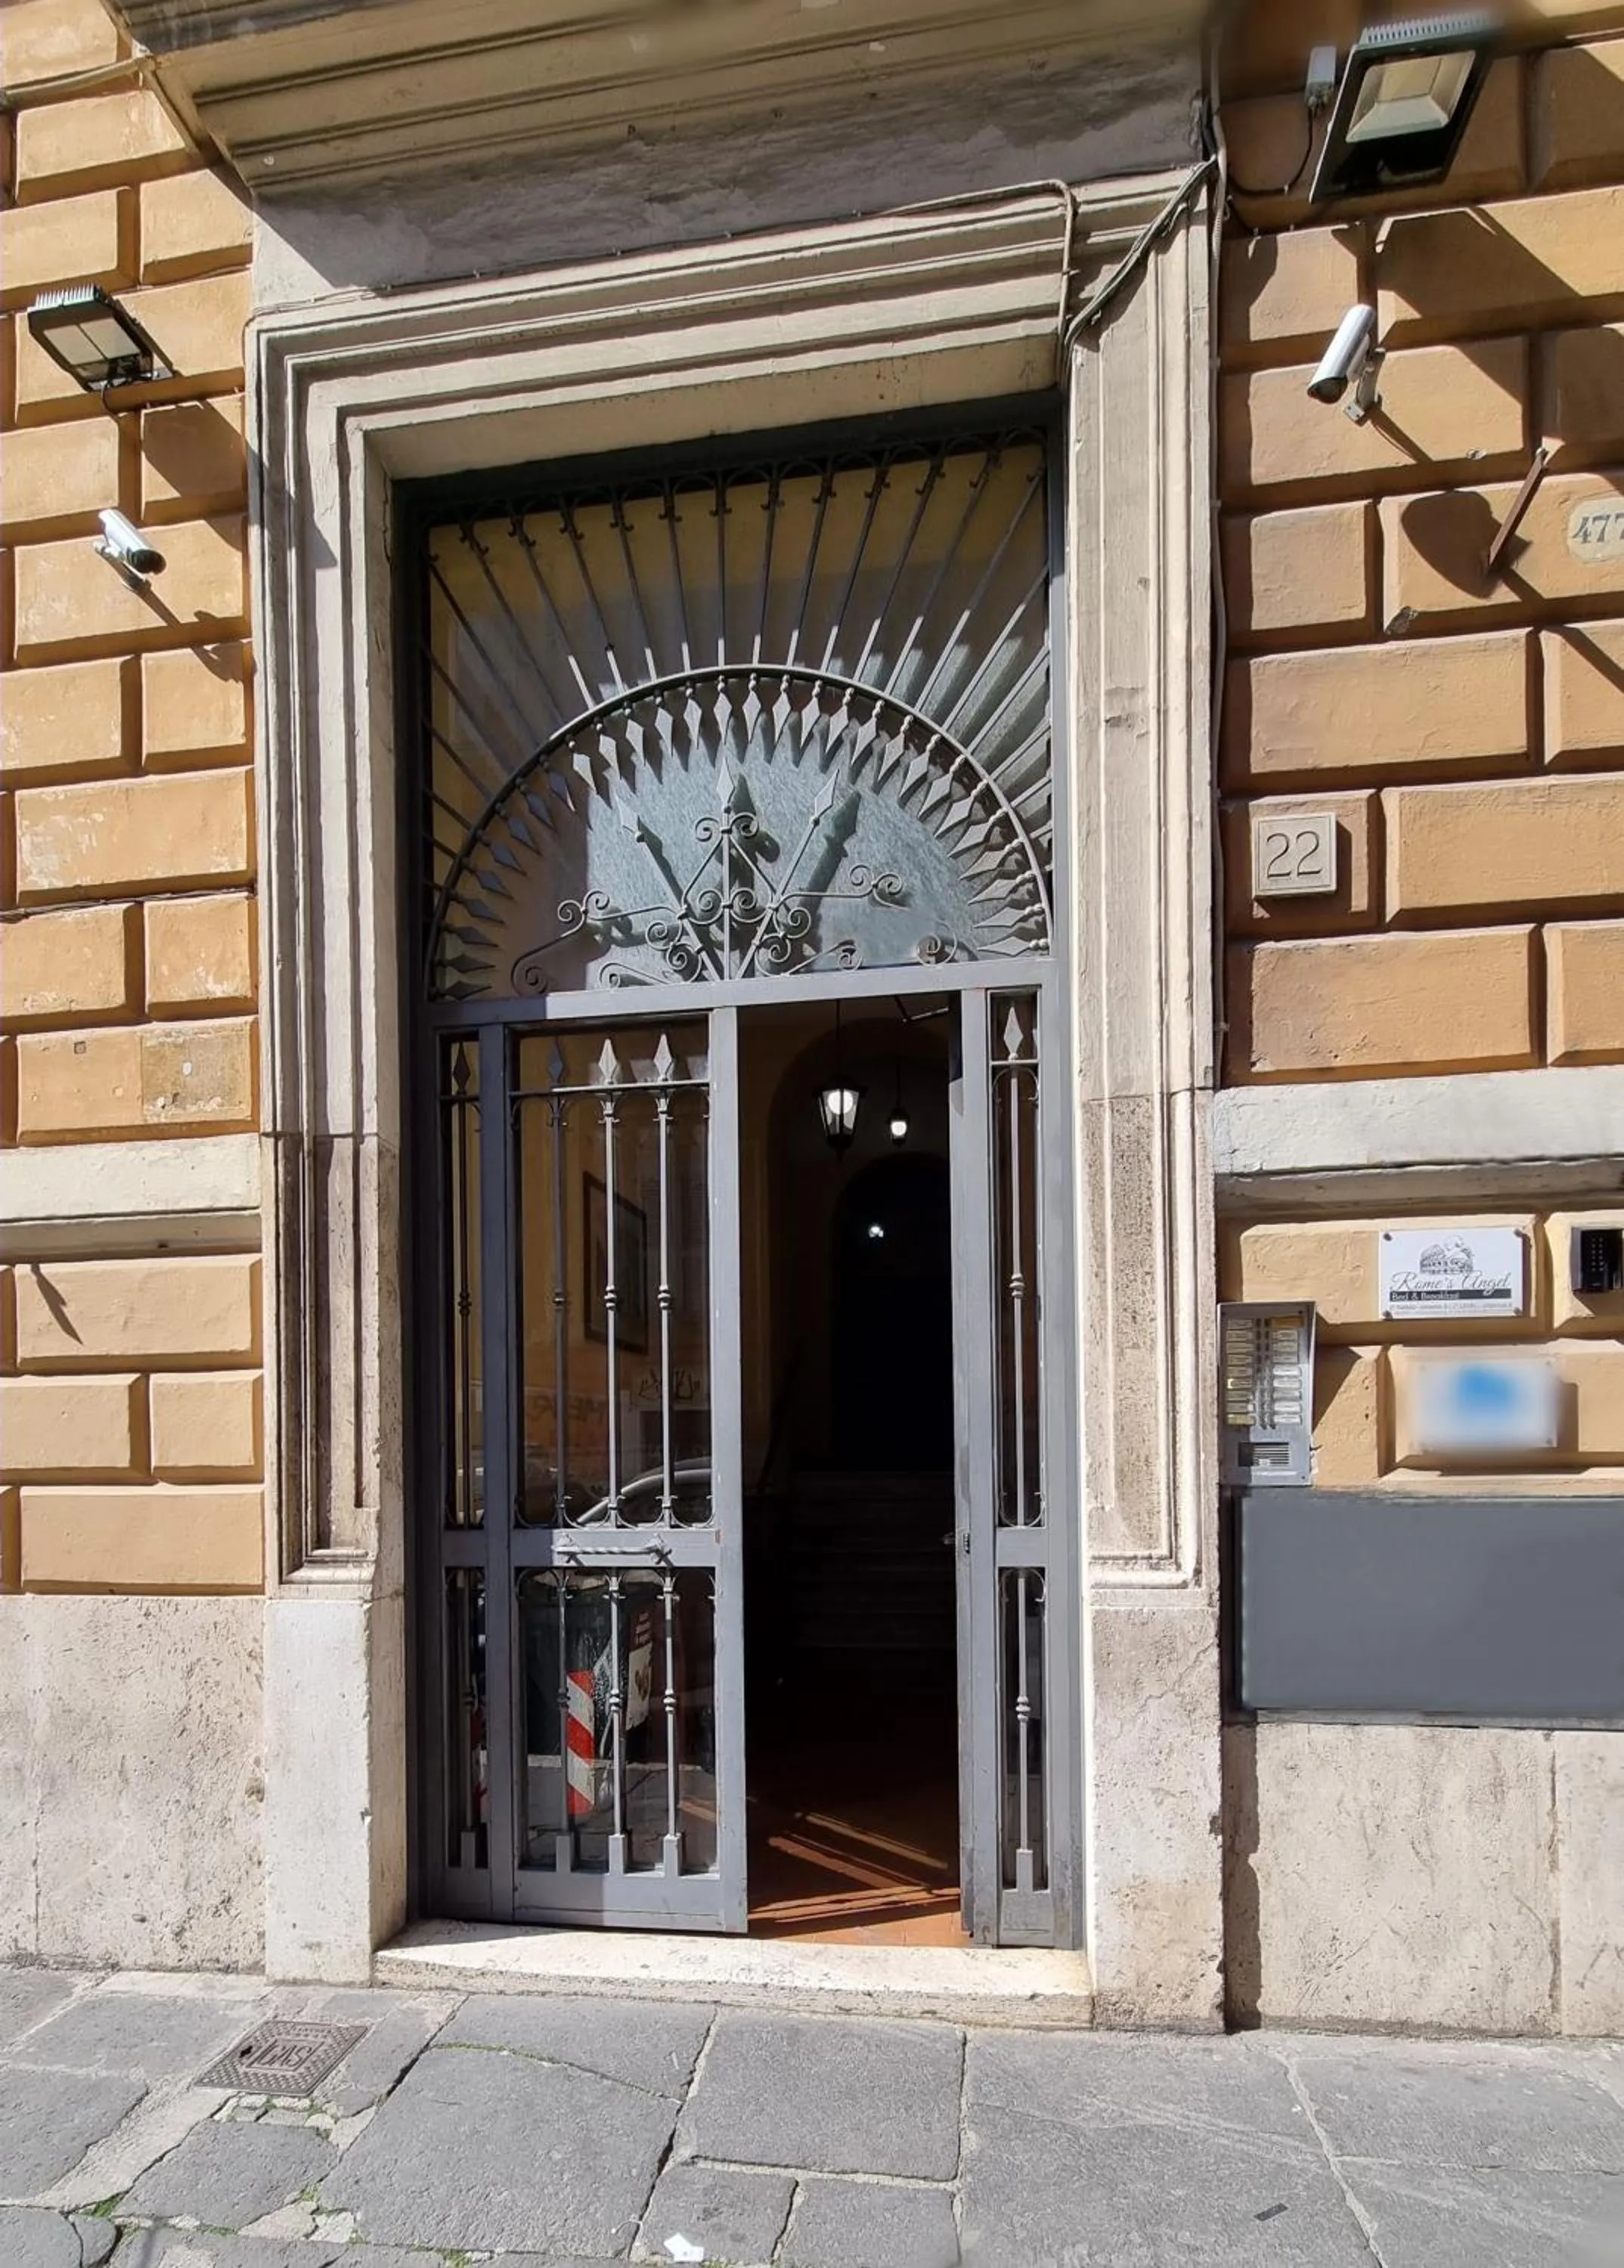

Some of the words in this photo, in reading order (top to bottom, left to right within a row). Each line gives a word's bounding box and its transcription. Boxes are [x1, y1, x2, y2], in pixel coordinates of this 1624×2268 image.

[1266, 831, 1322, 878] 22
[1390, 1270, 1452, 1291] Rome's
[1392, 1292, 1409, 1301] Bed
[258, 2045, 312, 2067] GAS
